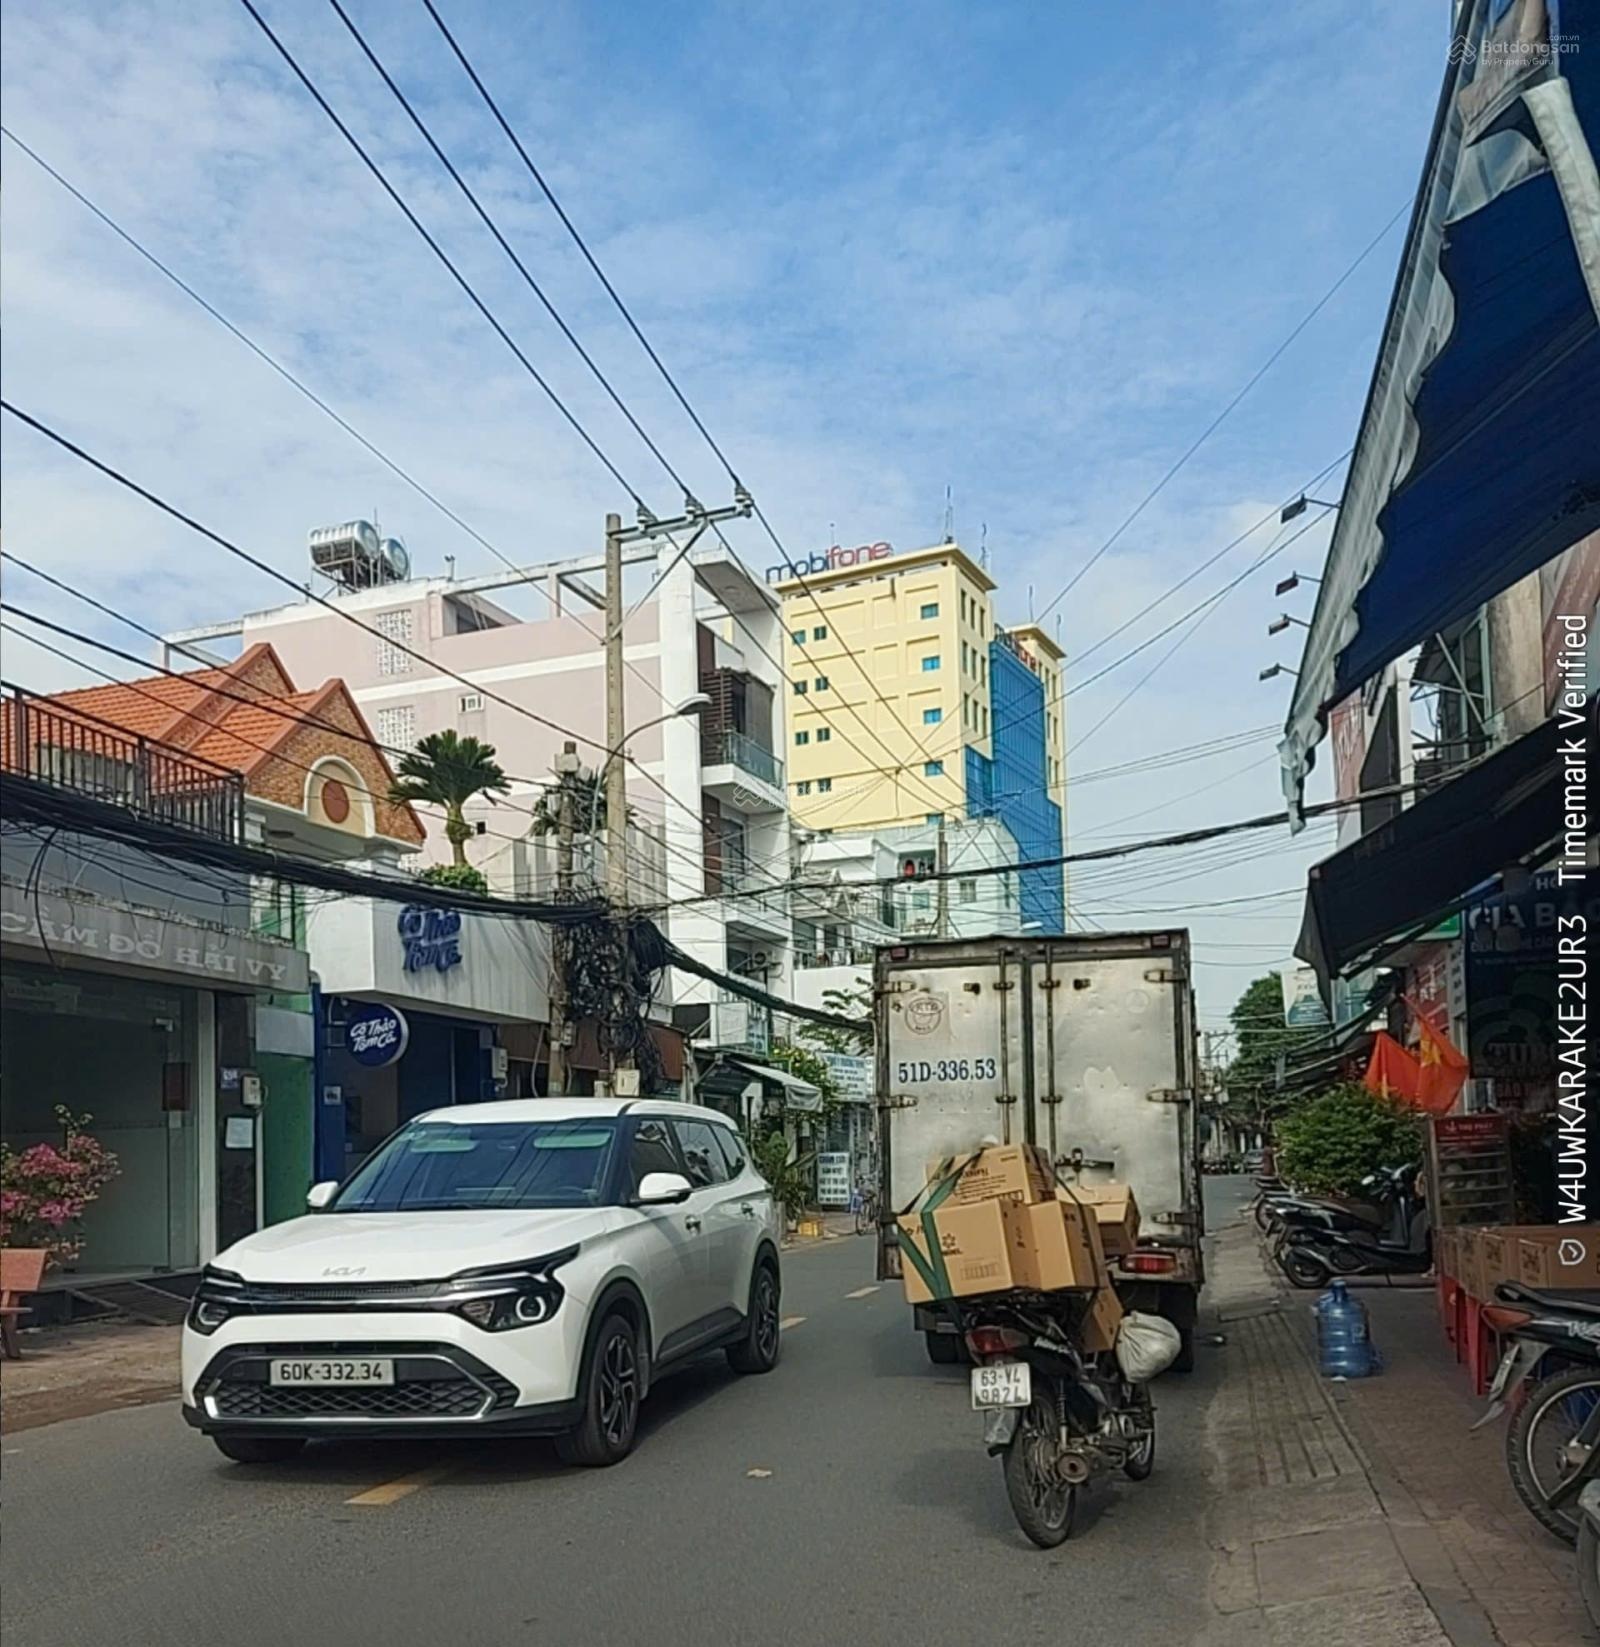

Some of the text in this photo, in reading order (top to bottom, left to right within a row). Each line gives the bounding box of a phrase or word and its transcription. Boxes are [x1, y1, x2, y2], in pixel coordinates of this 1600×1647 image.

[765, 541, 893, 585] mobifone
[109, 926, 161, 960] ĐỒ
[246, 957, 287, 981] VY
[350, 1017, 397, 1038] Cô Thảo
[353, 1035, 379, 1052] Tôm
[898, 1058, 996, 1084] 51D-336.53
[322, 1266, 366, 1276] KIA
[280, 1362, 383, 1381] 60K-332.34
